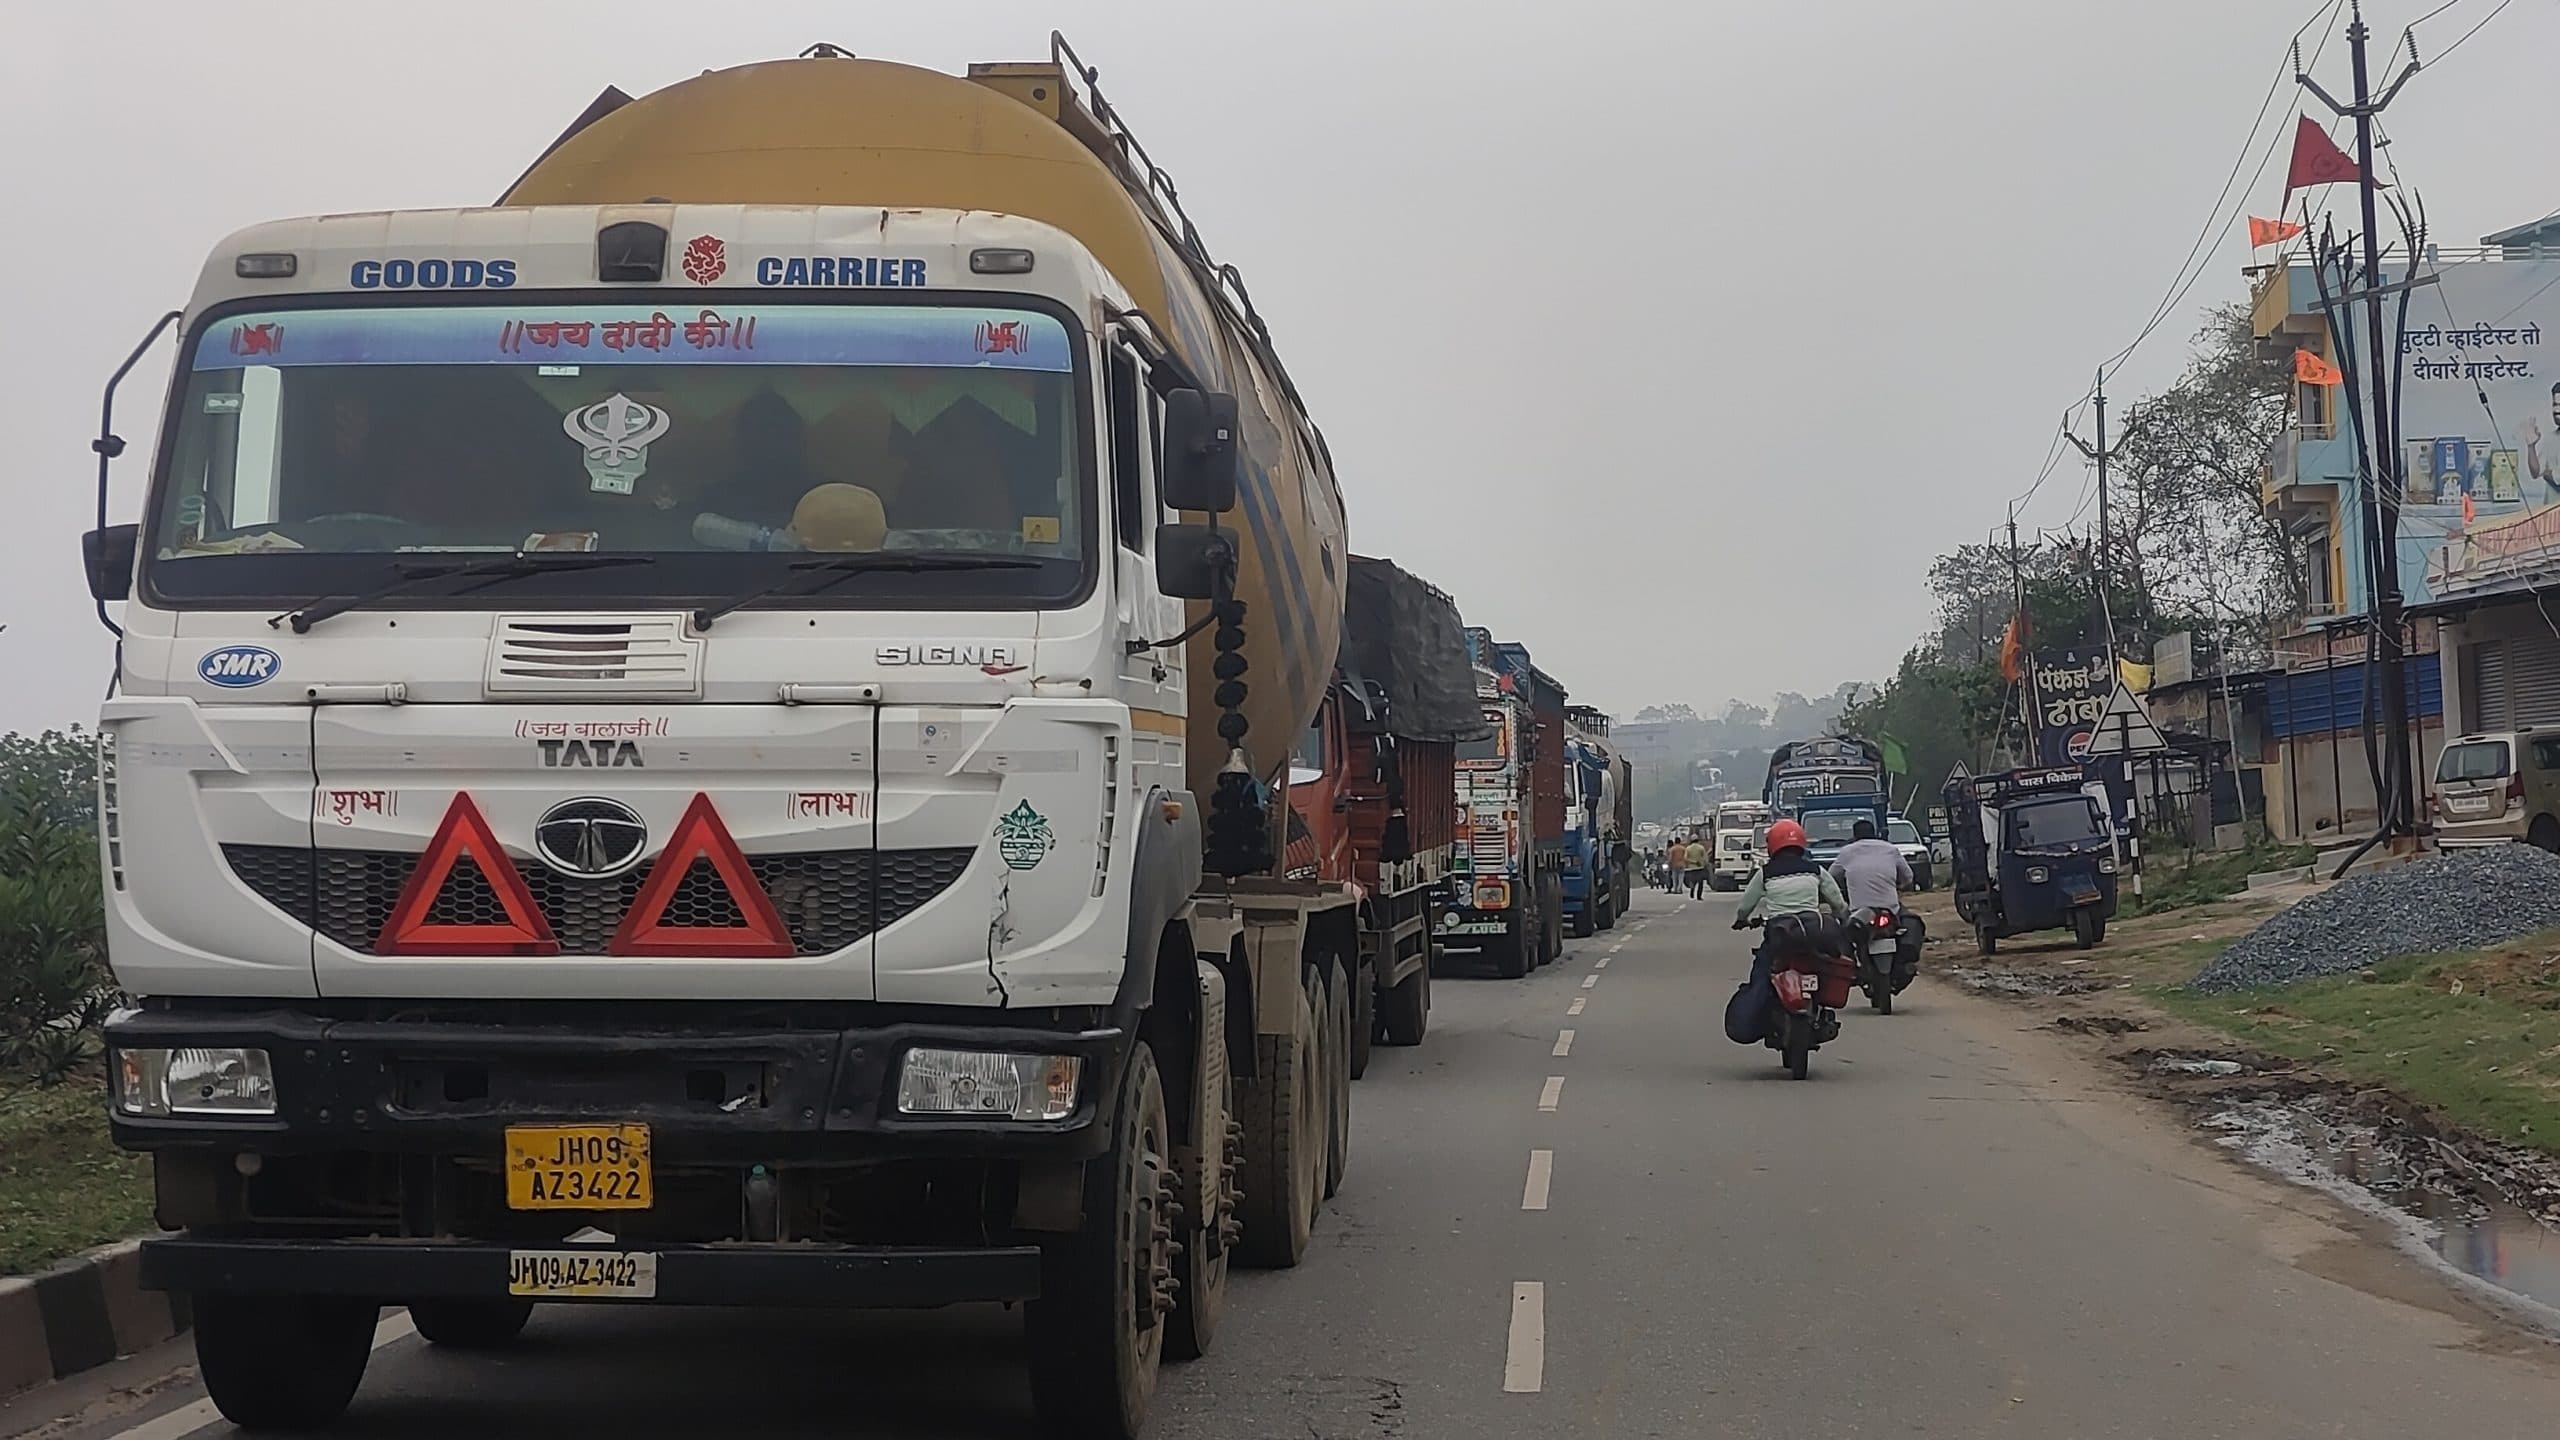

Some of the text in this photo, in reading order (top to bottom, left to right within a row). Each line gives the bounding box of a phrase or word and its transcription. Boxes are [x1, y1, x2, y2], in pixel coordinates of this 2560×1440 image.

[351, 257, 926, 289] GOODS CARRIER
[601, 312, 676, 352] दादी
[2521, 321, 2541, 345] तो
[2412, 354, 2460, 380] दीवारें
[206, 653, 272, 677] SMR
[876, 646, 1015, 666] SIGNA
[2038, 663, 2089, 692] पंकज
[538, 740, 644, 767] TATA
[550, 1136, 623, 1166] JH09
[531, 1171, 641, 1201] AZ3422
